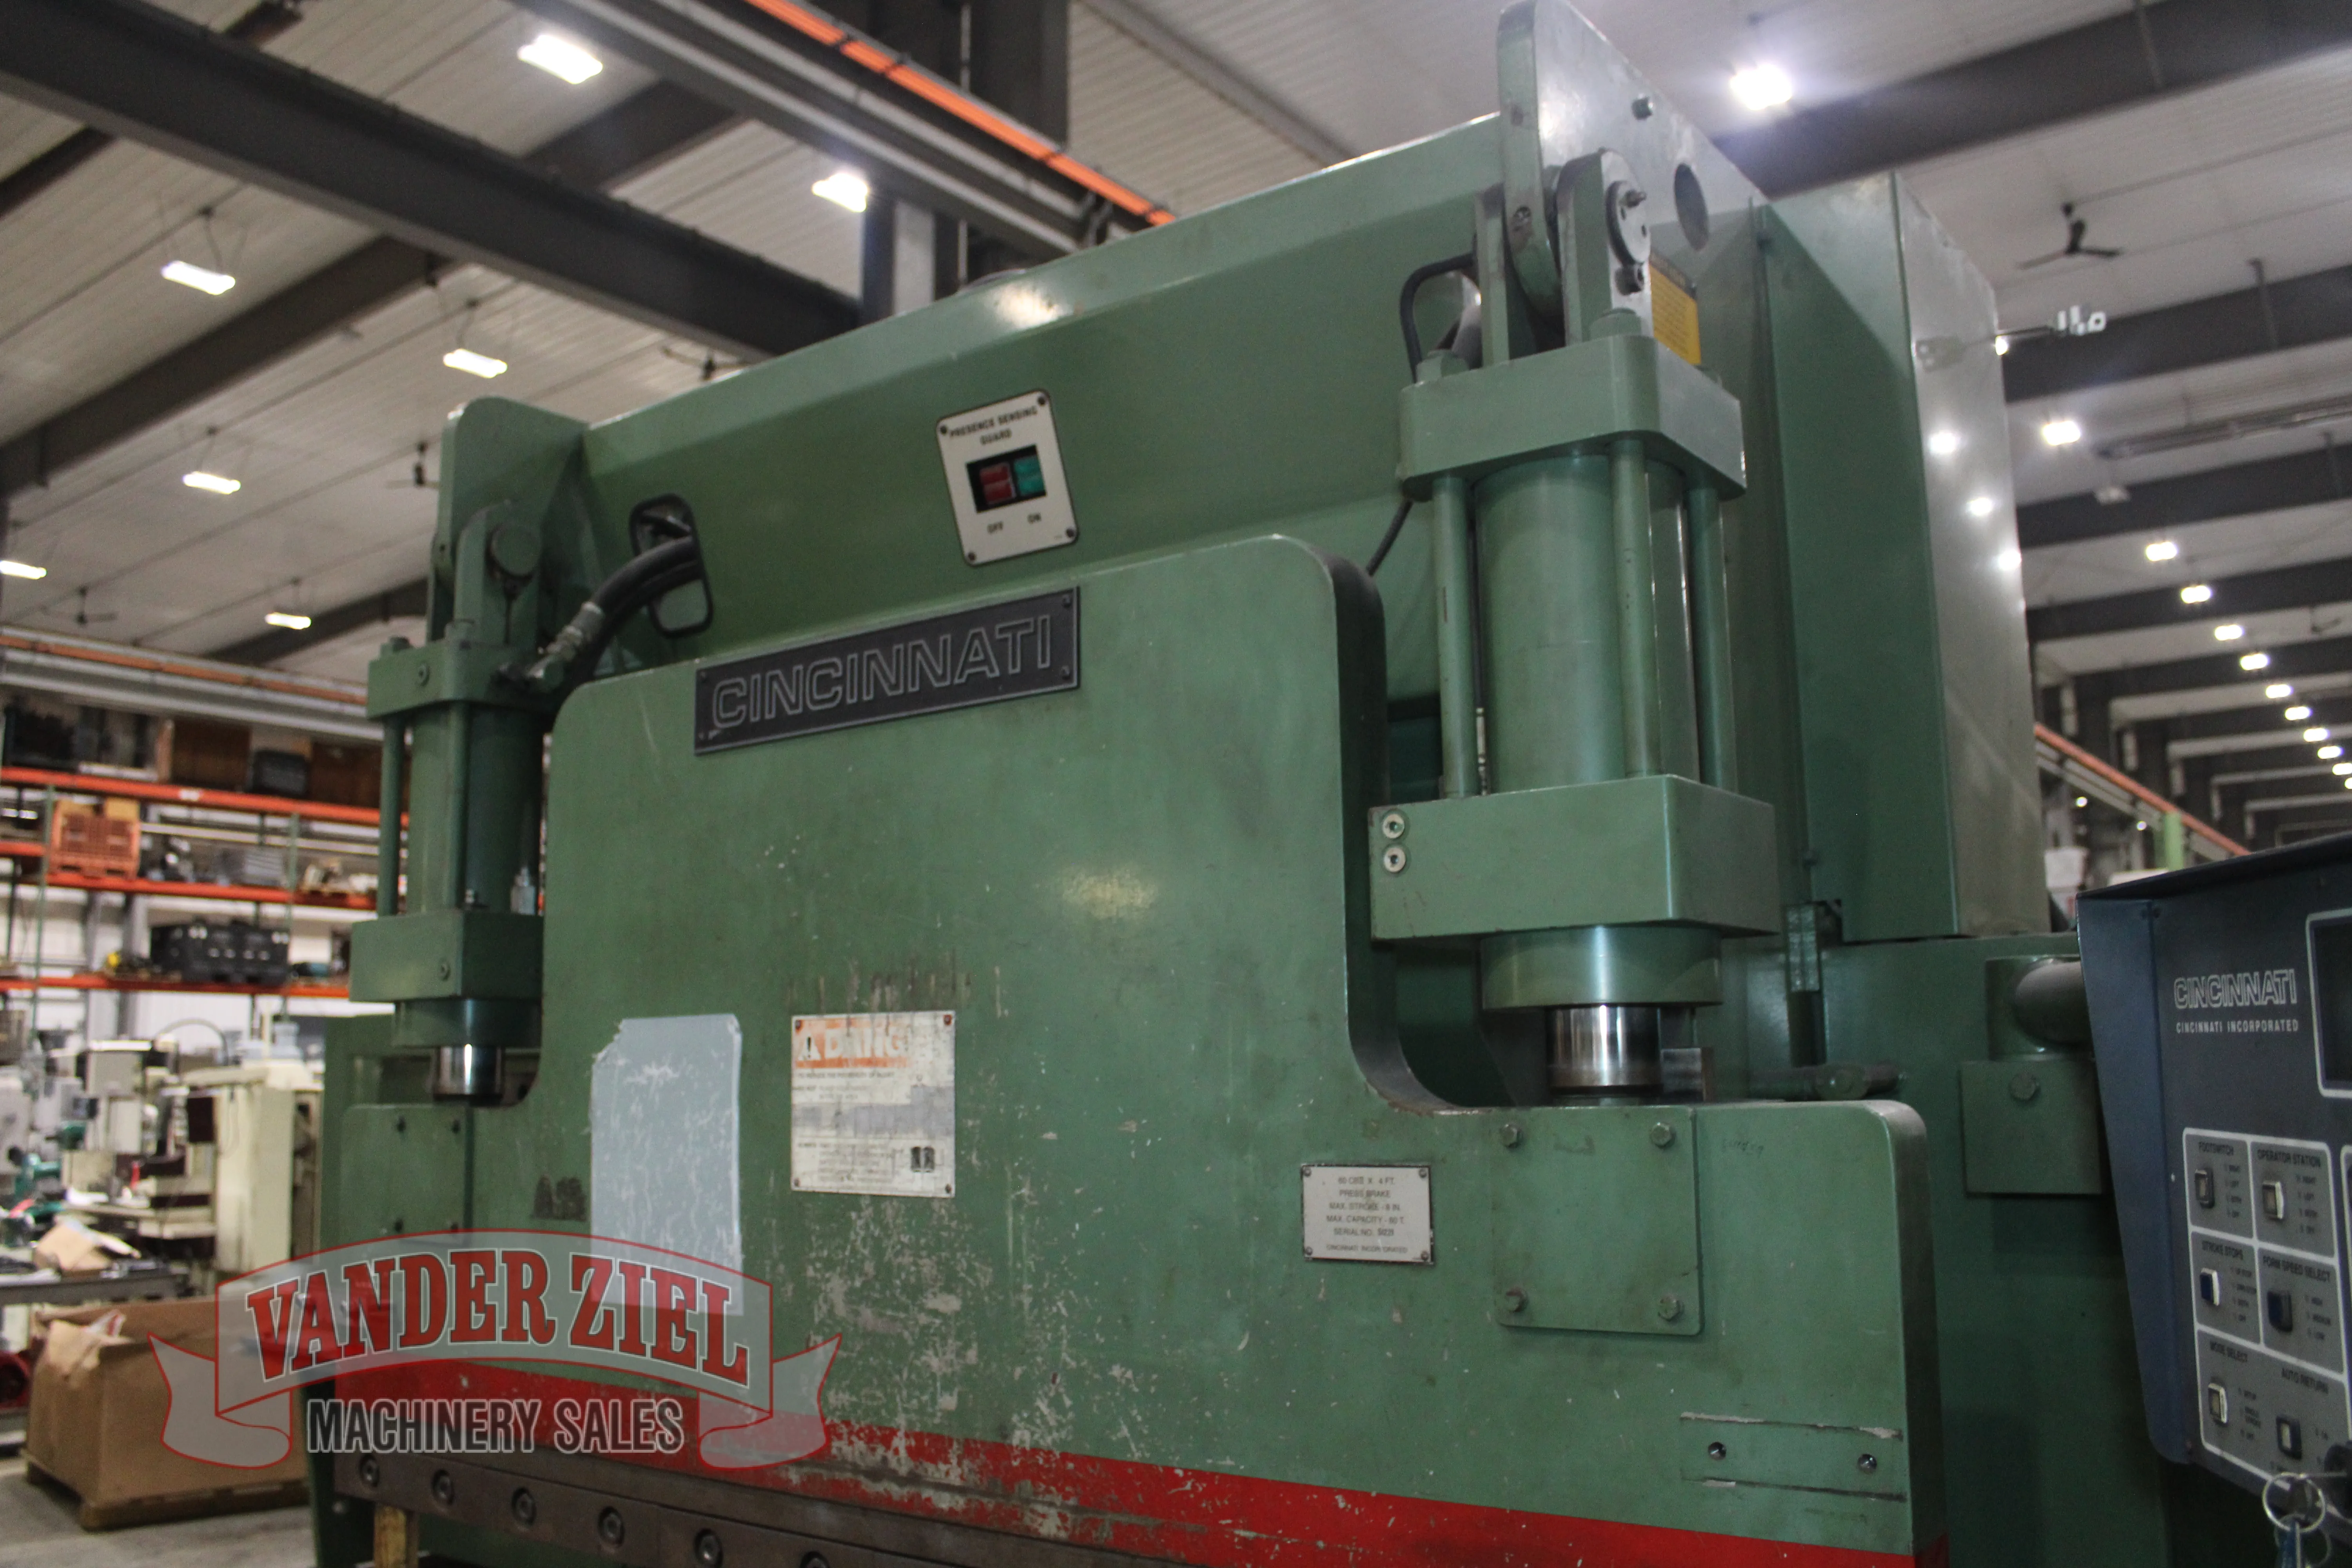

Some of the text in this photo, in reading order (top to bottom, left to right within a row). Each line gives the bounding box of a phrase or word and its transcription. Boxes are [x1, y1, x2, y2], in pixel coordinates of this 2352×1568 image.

[949, 406, 1038, 437] PRESENCE SENSING
[981, 428, 1012, 445] GUARD
[1027, 513, 1041, 524] ON
[987, 522, 1004, 534] OFF
[712, 615, 1051, 728] CINCINNATI
[2174, 969, 2297, 1009] CINCINNATI
[2176, 1019, 2299, 1033] CINCINNATI INCORPORATED
[2257, 1149, 2321, 1167] OPERATOR STATION
[1366, 1189, 1390, 1198] BRAKE
[1347, 1215, 1383, 1224] CAPACITY
[1334, 1227, 1359, 1236] SERIAL
[2305, 1266, 2330, 1282] SELECT
[2281, 1367, 2299, 1384] AUTO
